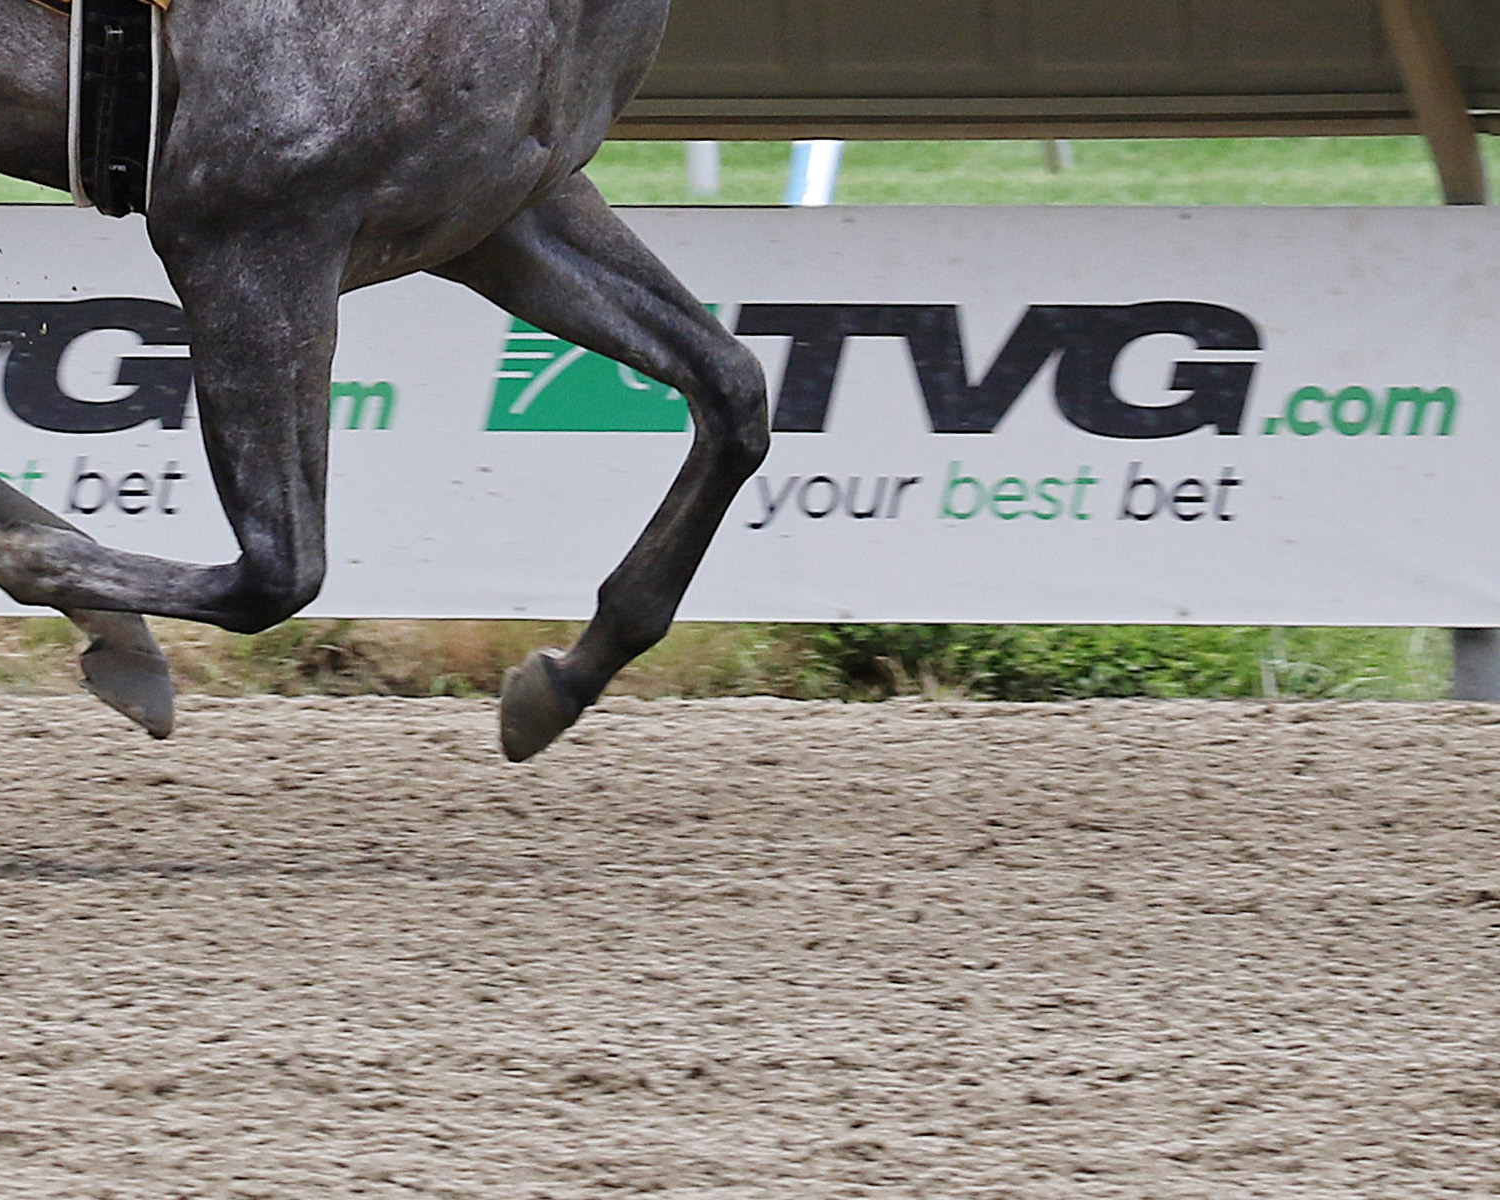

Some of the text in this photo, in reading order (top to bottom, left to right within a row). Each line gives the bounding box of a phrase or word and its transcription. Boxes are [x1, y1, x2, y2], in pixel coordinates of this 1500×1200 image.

[64, 455, 187, 515] bet
[744, 461, 1246, 531] your best bet
